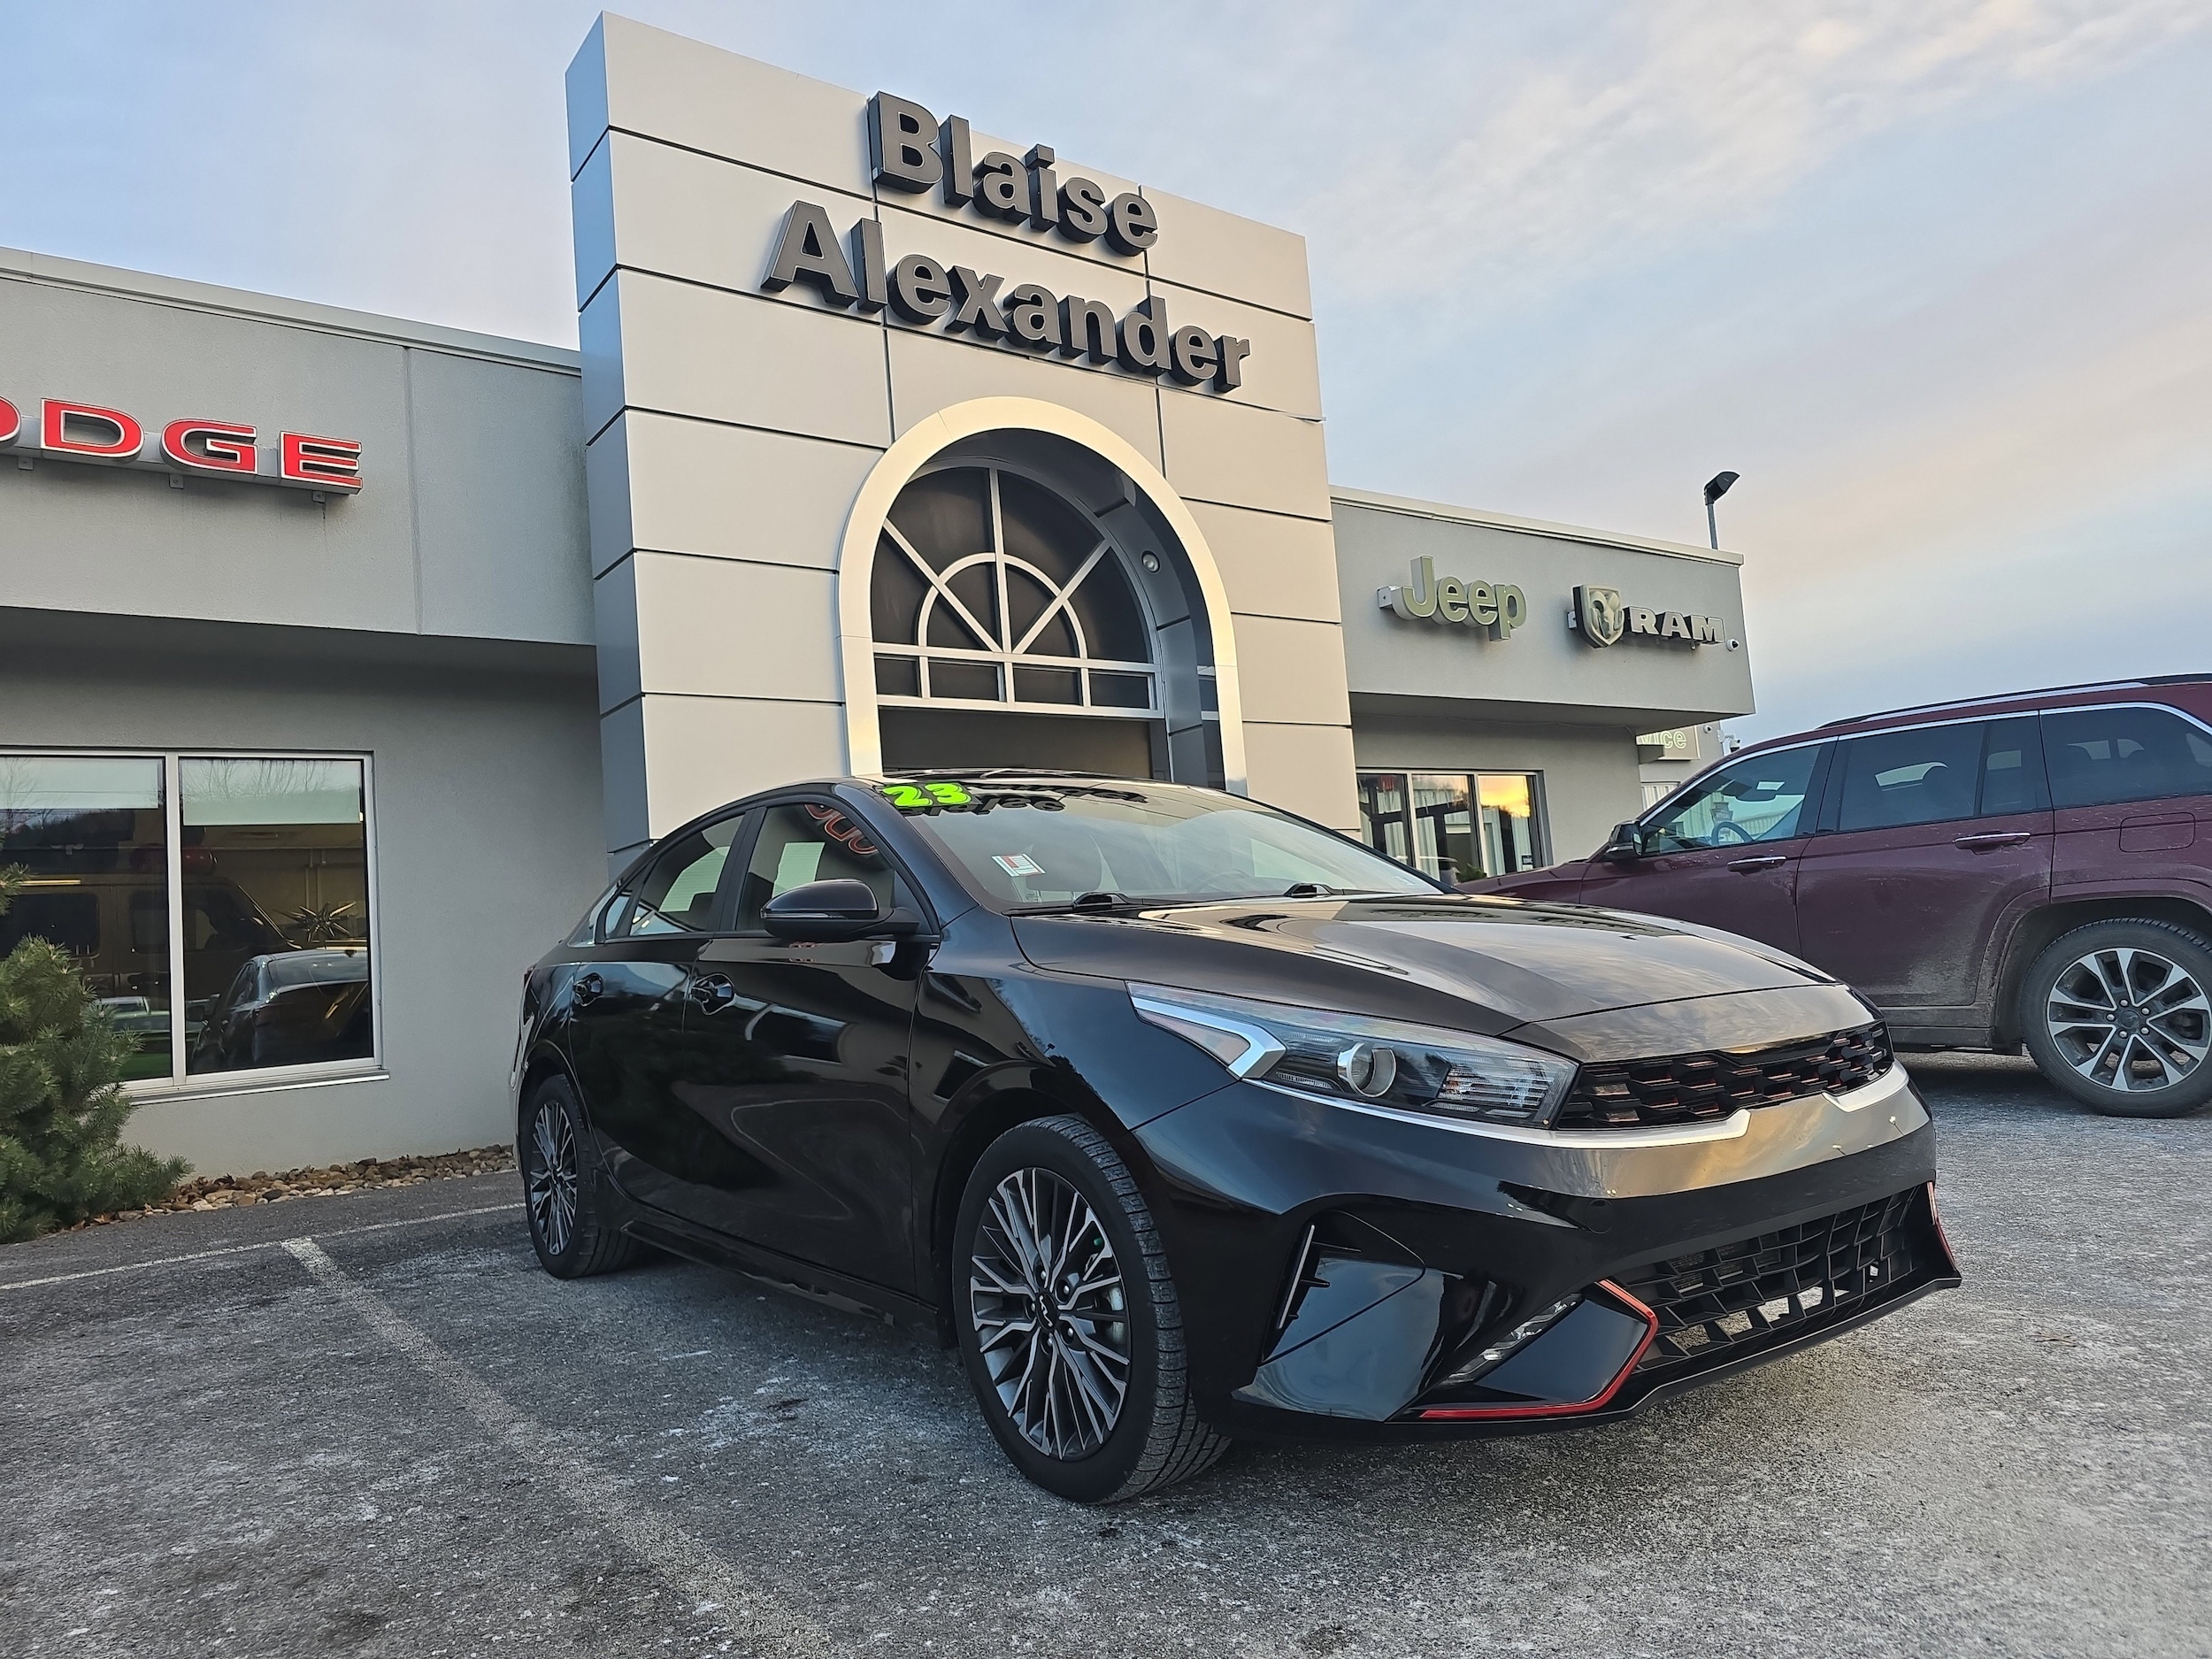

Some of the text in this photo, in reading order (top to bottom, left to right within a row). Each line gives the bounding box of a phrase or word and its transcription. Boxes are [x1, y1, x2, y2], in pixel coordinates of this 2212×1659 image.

[868, 91, 1159, 257] Blaise
[761, 200, 1250, 393] Alexander
[0, 396, 363, 494] DGE
[1392, 556, 1527, 641] Jeep
[1626, 605, 1726, 644] RAM
[884, 781, 972, 808] 23
